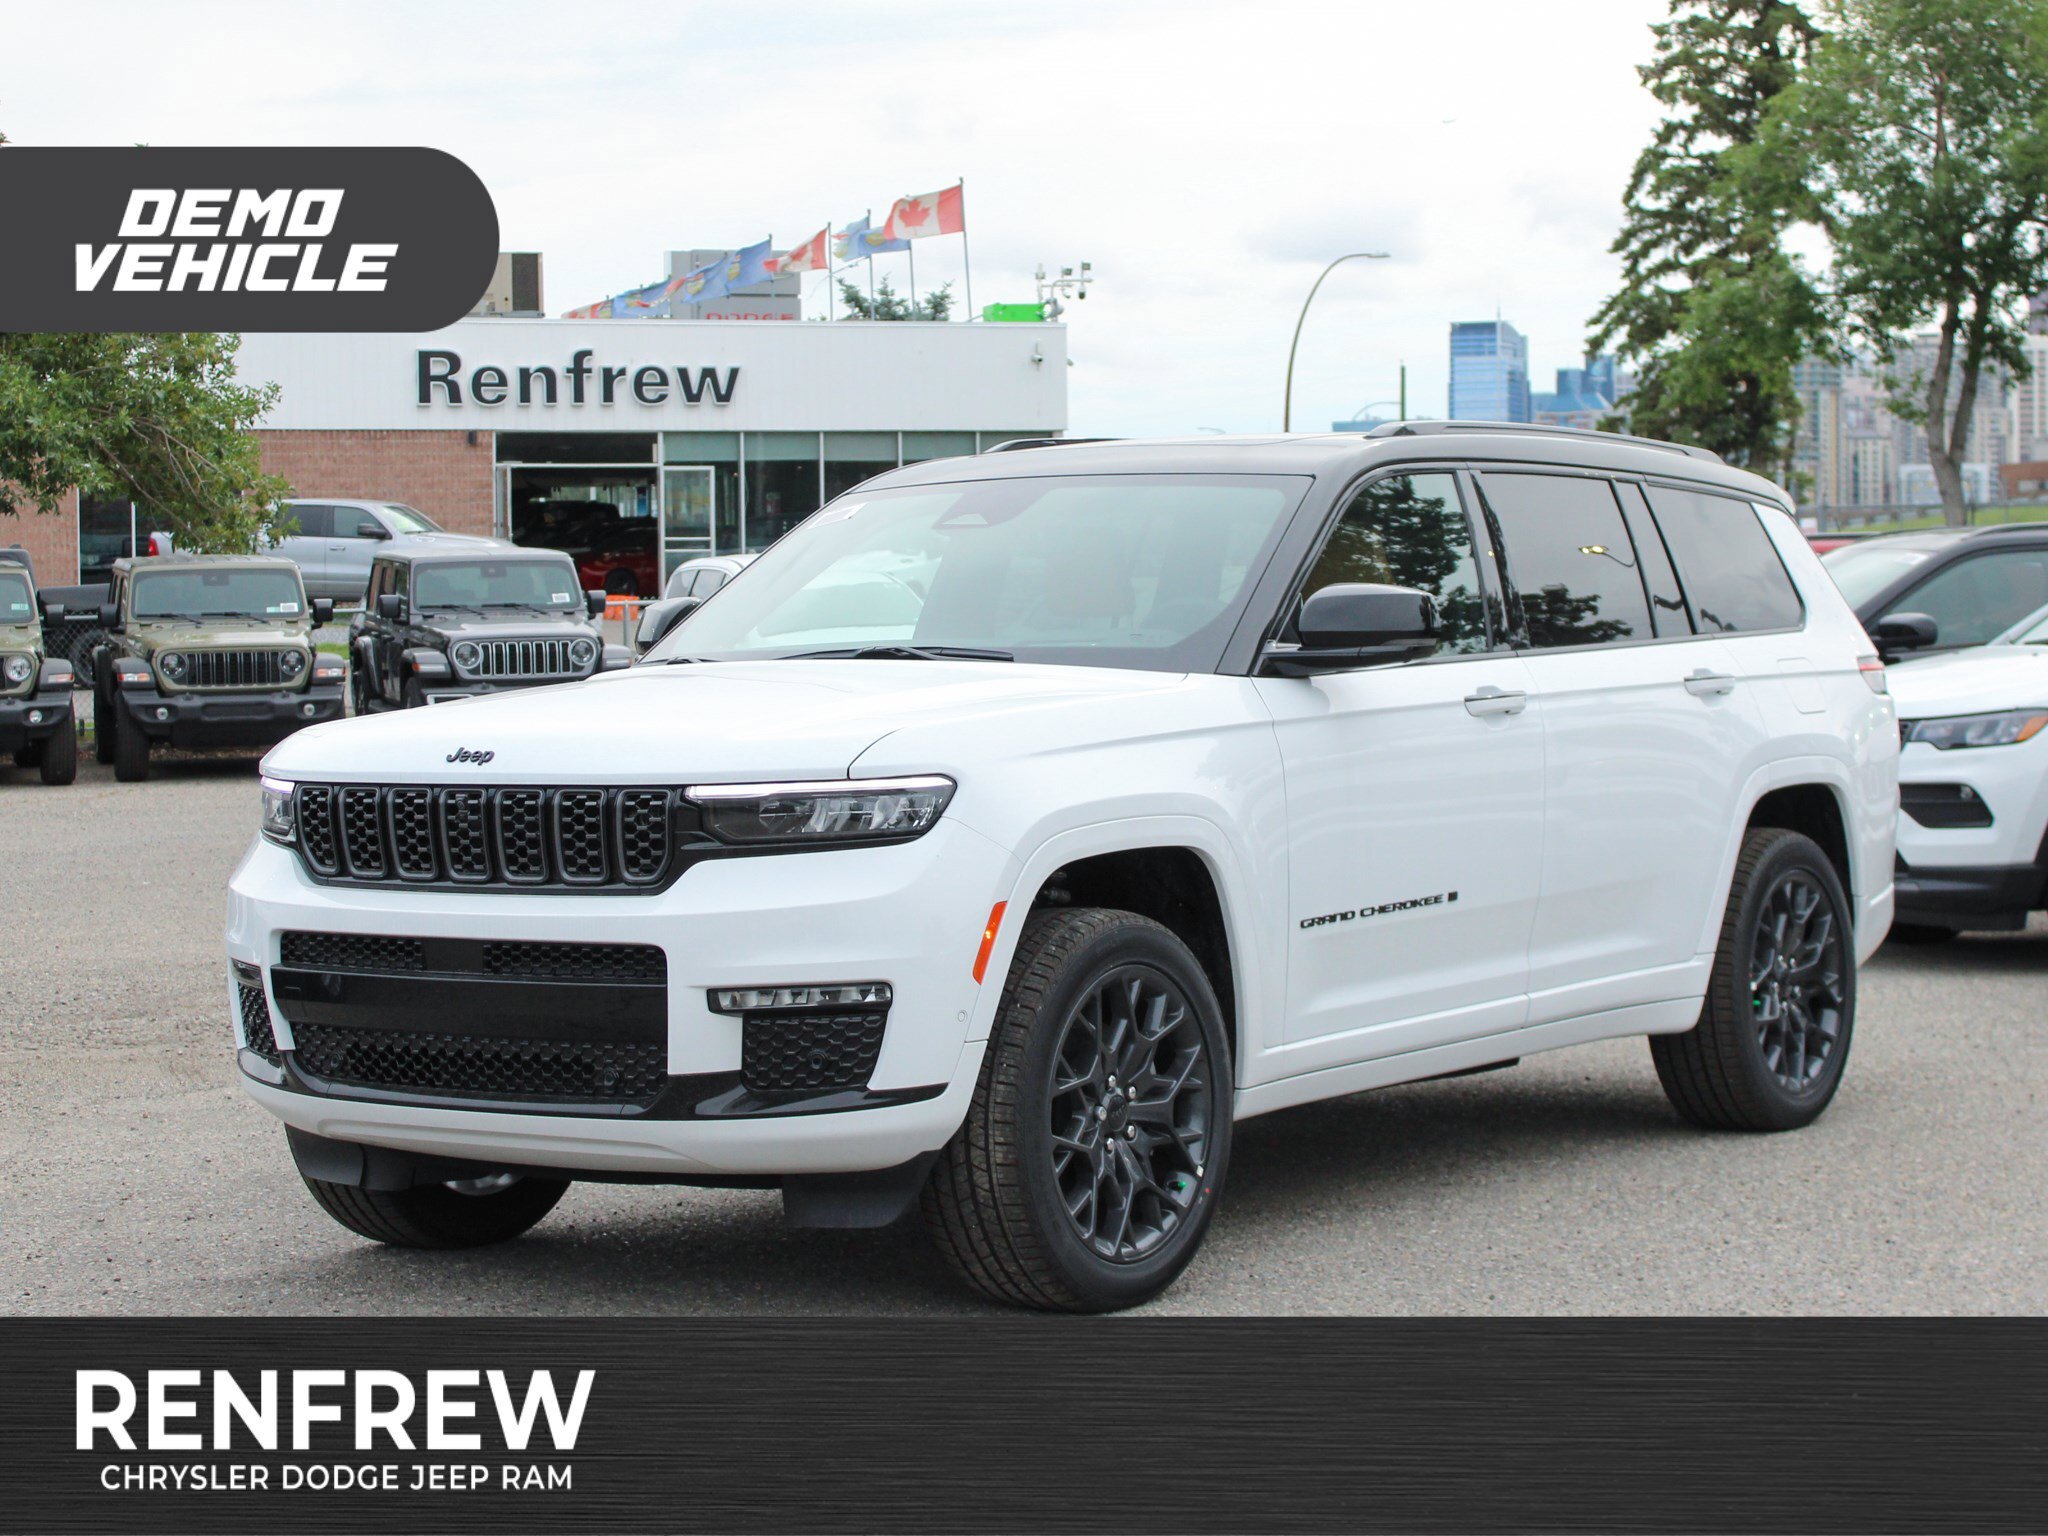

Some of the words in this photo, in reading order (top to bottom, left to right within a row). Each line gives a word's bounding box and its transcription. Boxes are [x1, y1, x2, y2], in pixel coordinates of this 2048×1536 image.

[417, 349, 740, 406] Renfrew
[446, 747, 495, 766] Jeep
[1300, 910, 1356, 929] GRAND
[1359, 893, 1444, 918] CHEROKEE
